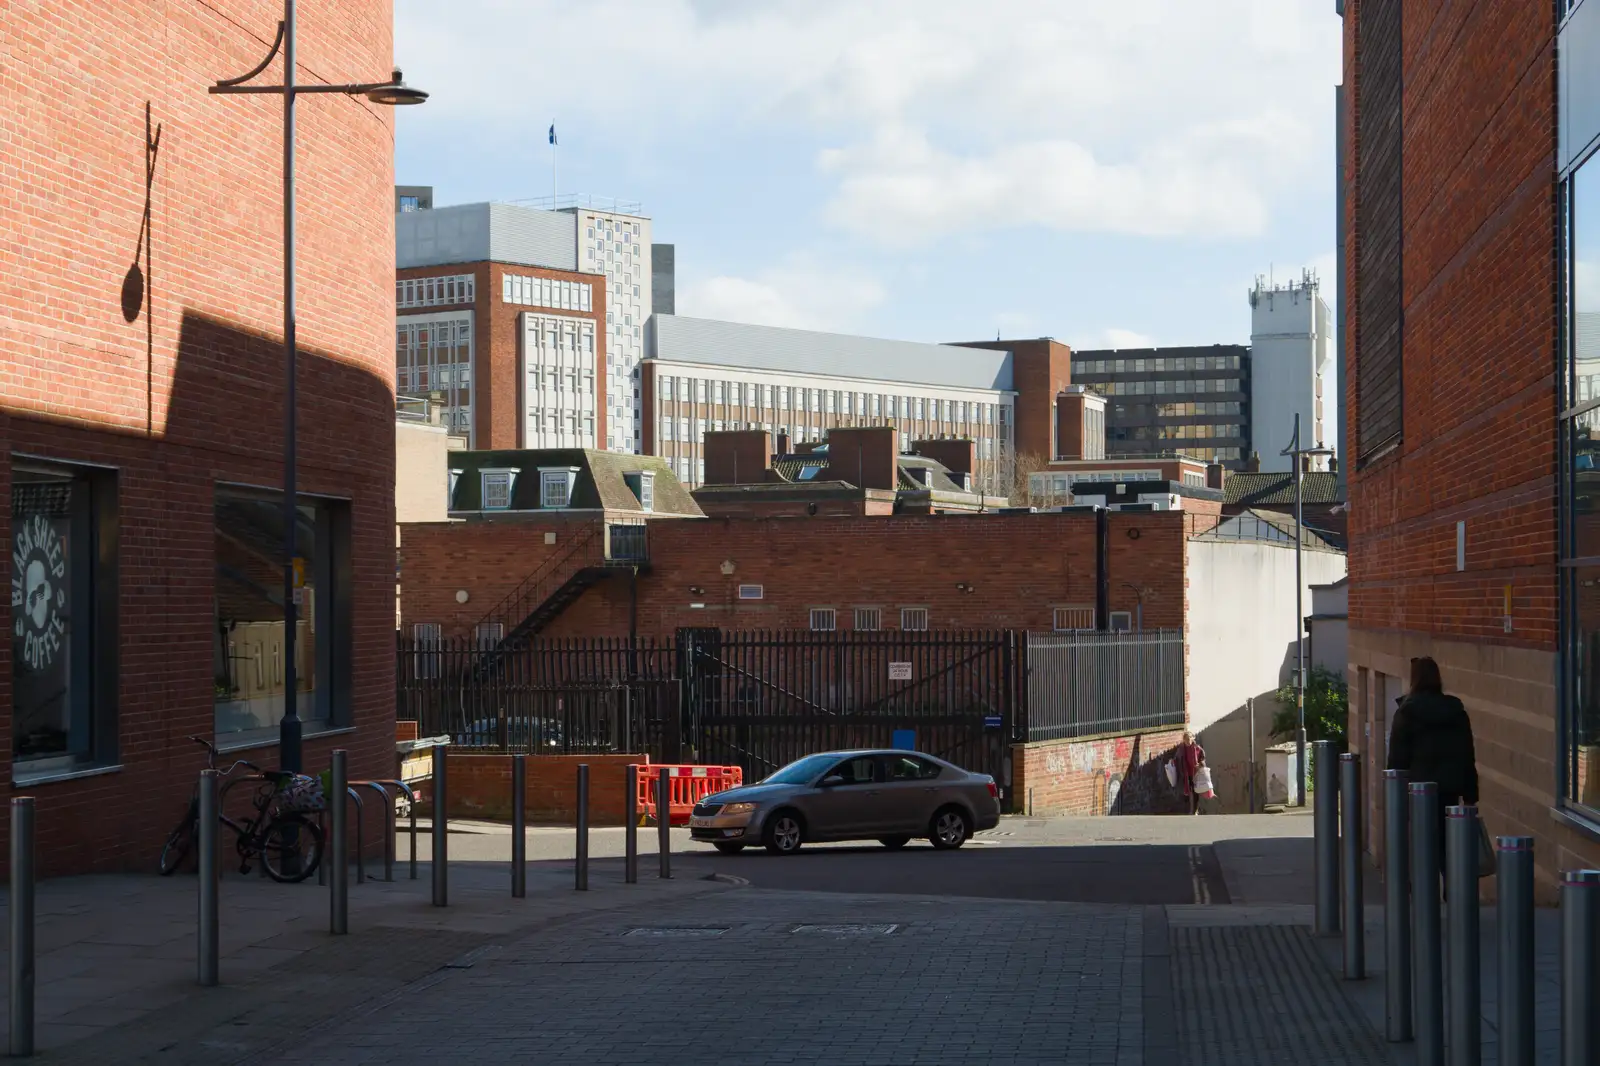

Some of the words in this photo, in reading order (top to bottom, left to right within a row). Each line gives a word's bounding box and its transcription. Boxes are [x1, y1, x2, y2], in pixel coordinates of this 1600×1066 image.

[12, 520, 33, 606] BLACK
[34, 515, 65, 580] SHEEP
[24, 610, 65, 669] COFFEE
